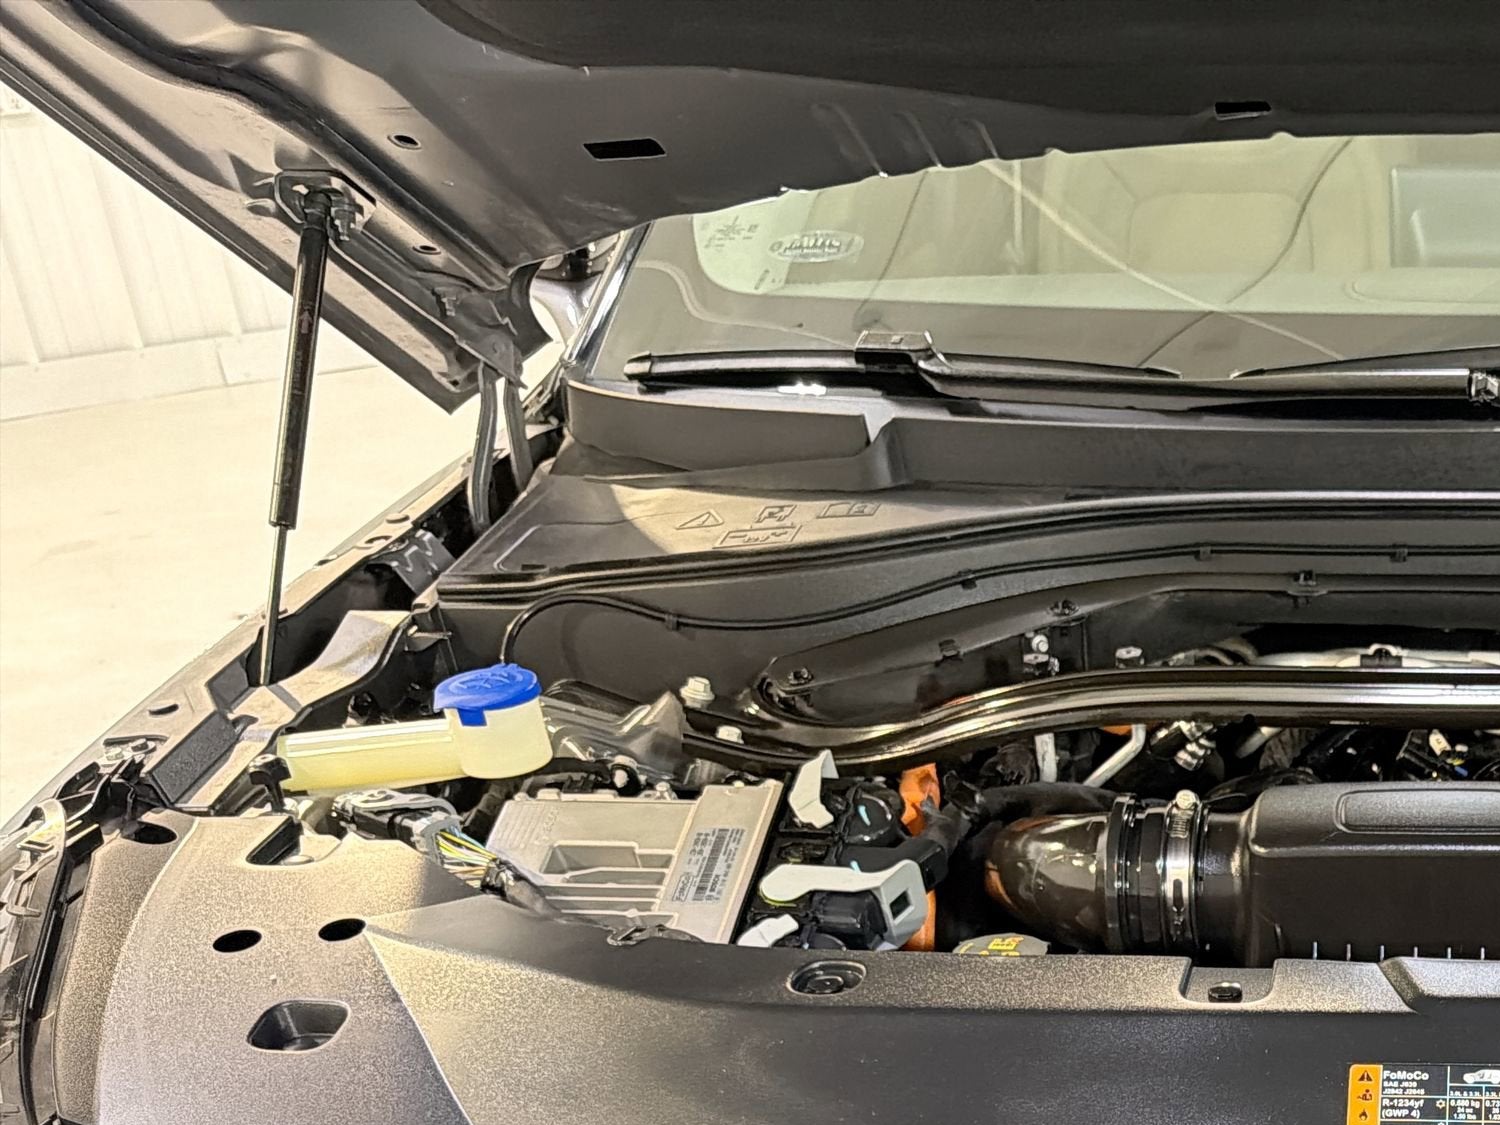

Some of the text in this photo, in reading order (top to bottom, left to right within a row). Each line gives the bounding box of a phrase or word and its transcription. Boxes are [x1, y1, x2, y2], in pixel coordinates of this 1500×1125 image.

[1383, 1070, 1429, 1080] FoMoCo
[1382, 1098, 1424, 1109] R-1234yf
[1470, 1100, 1480, 1108] kg
[1381, 1109, 1420, 1118] (GWP 4)
